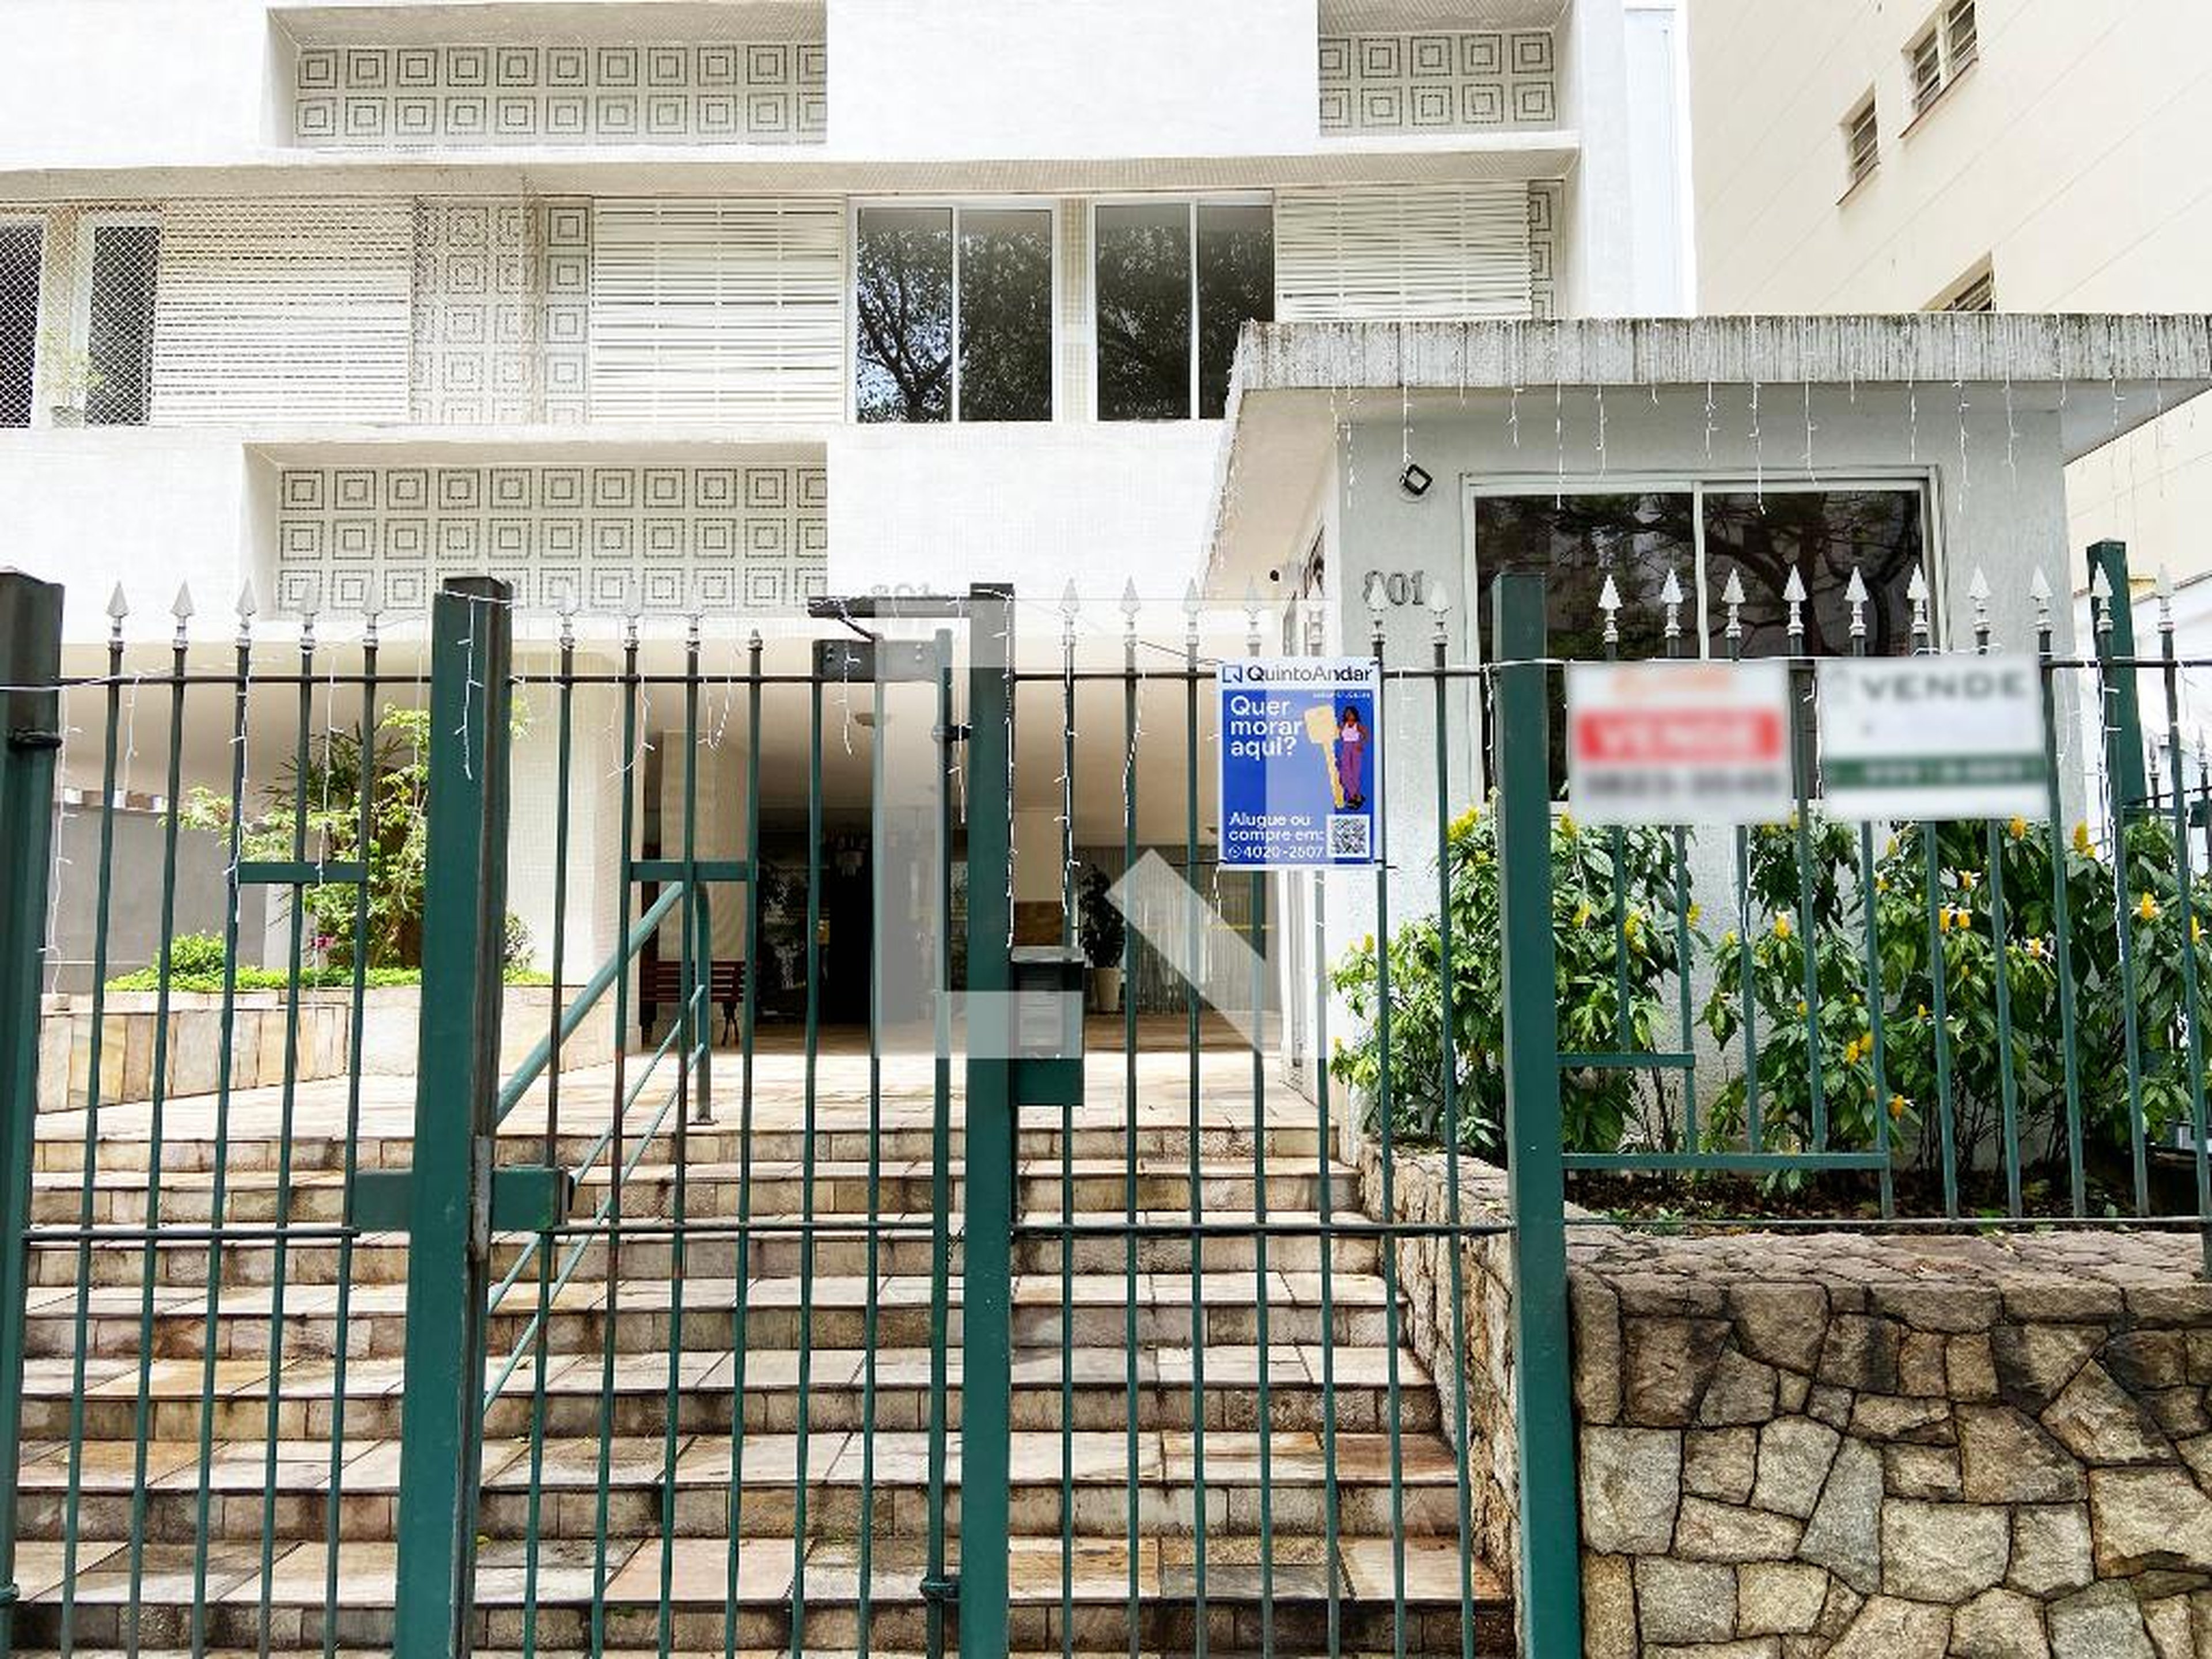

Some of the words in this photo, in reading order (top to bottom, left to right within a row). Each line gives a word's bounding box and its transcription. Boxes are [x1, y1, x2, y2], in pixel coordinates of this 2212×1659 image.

[1247, 665, 1373, 681] QuintoAndar
[1230, 695, 1290, 716] Quer
[1230, 721, 1302, 735] morar
[1231, 736, 1297, 760] aqui?
[1228, 812, 1286, 830] Alugue
[1290, 816, 1311, 825] ou
[1228, 830, 1292, 843] compre
[1296, 830, 1325, 841] em:
